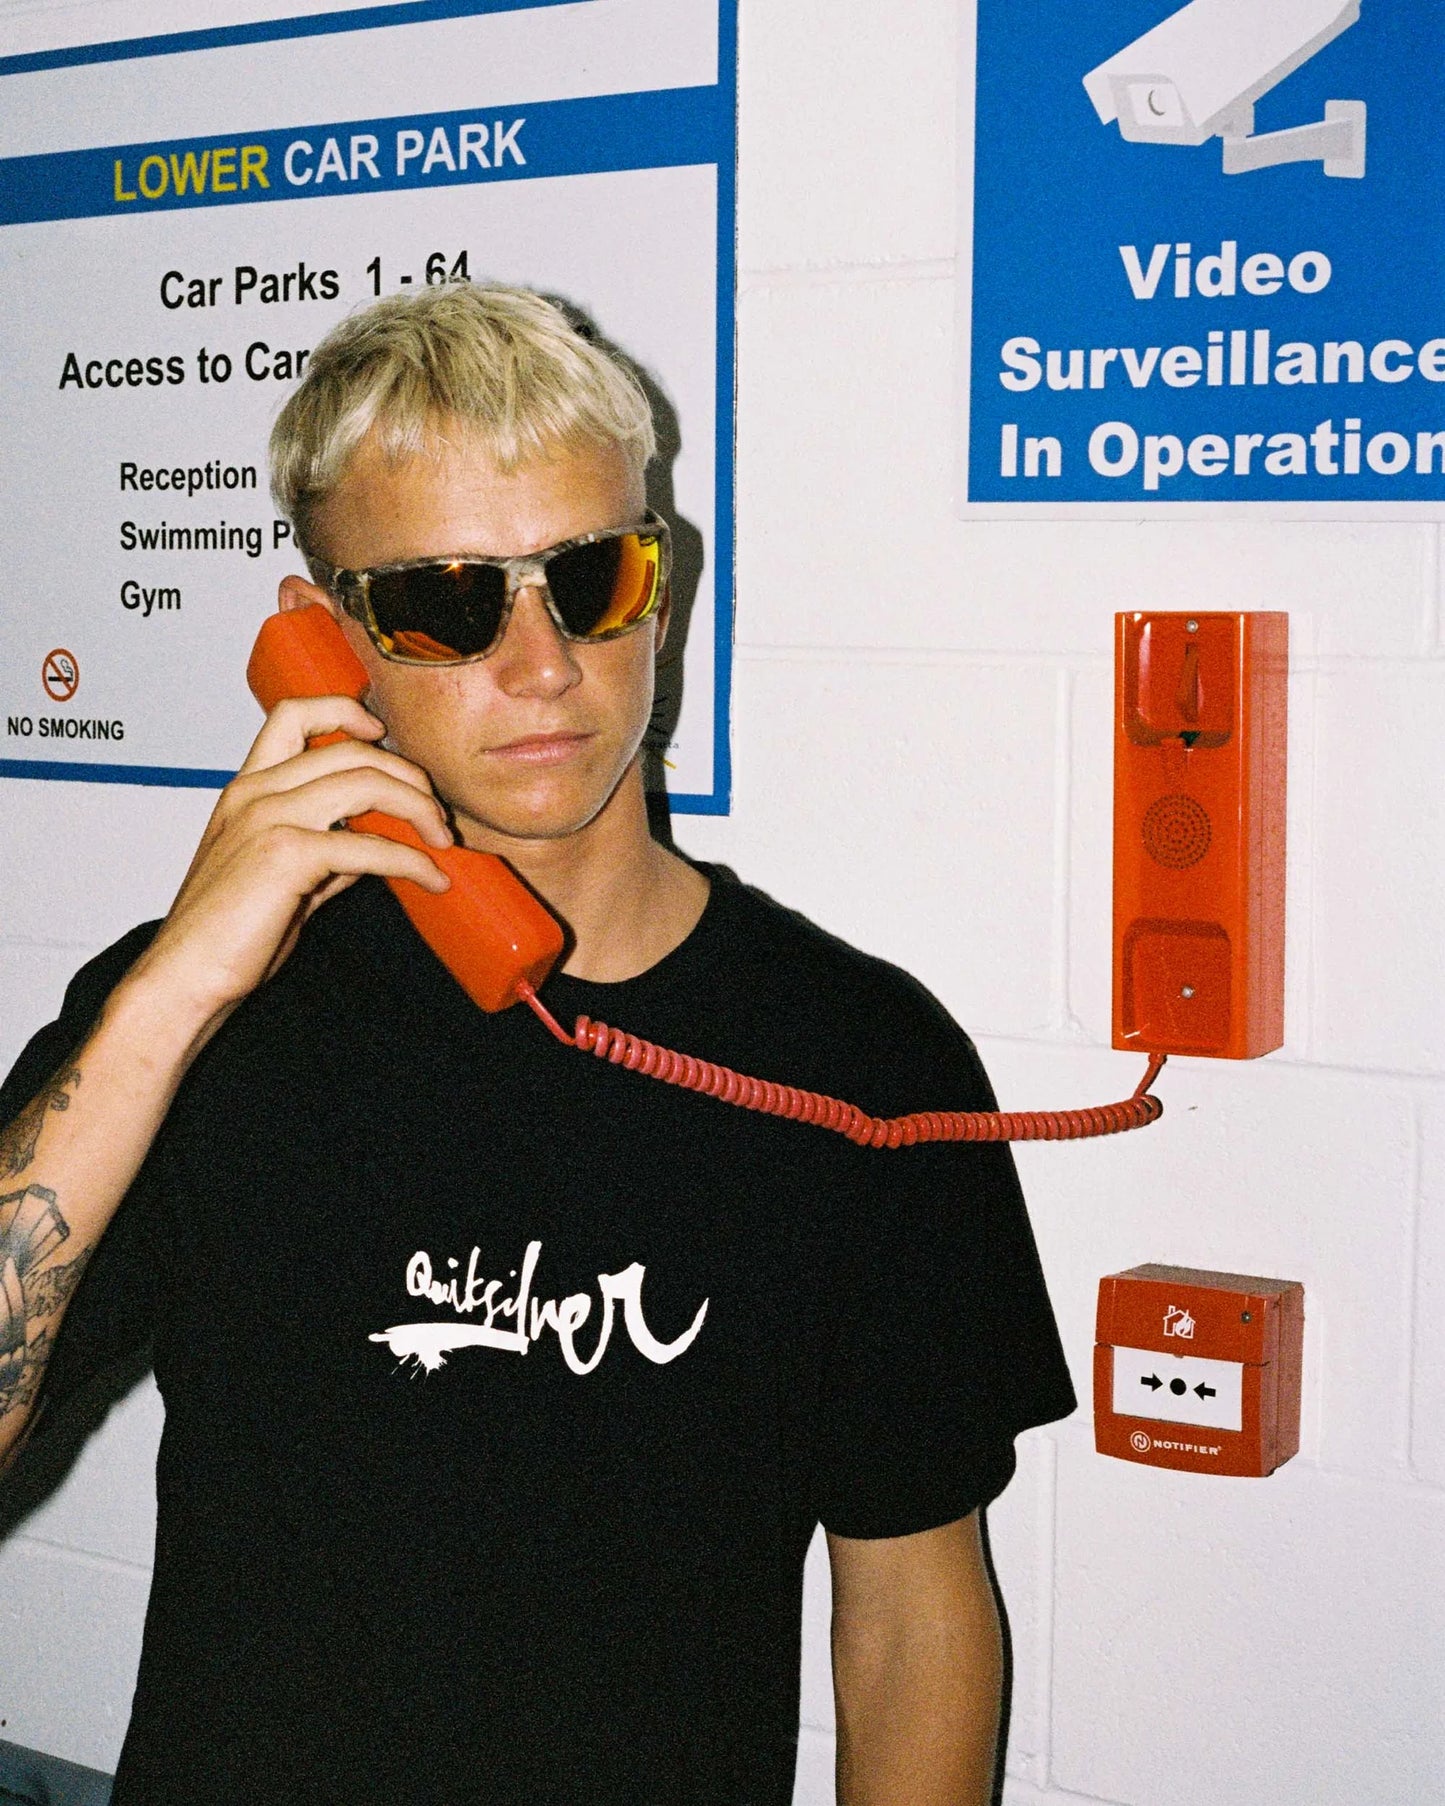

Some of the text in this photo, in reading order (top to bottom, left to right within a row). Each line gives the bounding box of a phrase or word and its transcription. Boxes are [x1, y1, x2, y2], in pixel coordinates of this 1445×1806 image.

[113, 119, 527, 202] LOWER CAR PARK
[161, 251, 470, 309] Car Parks 1 - 64
[1119, 241, 1331, 299] Video
[59, 341, 310, 389] Access to Car
[1000, 330, 1445, 391] Surveillance
[121, 460, 256, 497] Reception
[1001, 418, 1445, 490] In Operation
[121, 520, 299, 557] Swimming P
[121, 581, 180, 617] Gym
[8, 717, 124, 740] NO SMOKING
[368, 1241, 709, 1375] Quiksilver
